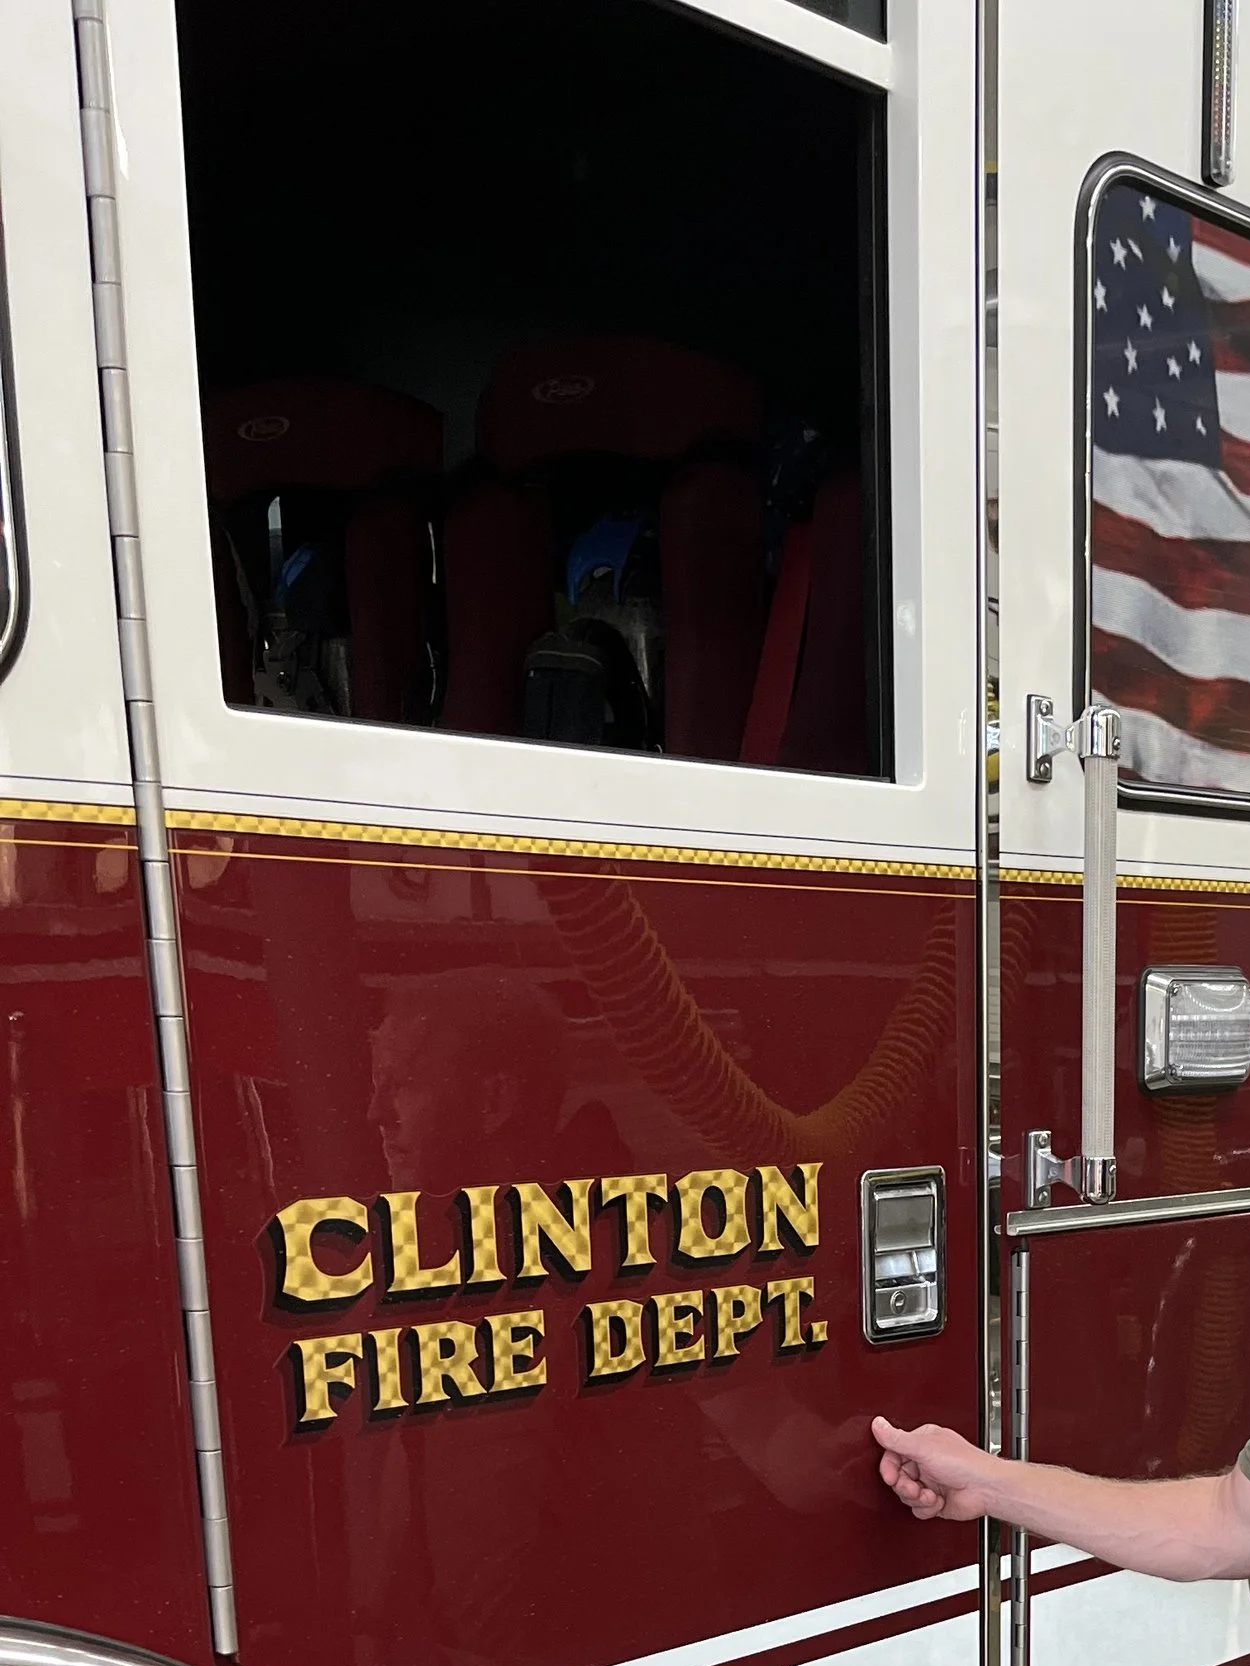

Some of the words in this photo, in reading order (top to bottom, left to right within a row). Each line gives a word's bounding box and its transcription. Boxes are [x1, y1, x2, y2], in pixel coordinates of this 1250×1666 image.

[274, 1161, 824, 1304] CLINTON
[292, 1309, 548, 1424] FIRE
[585, 1276, 829, 1379] DEPT.
